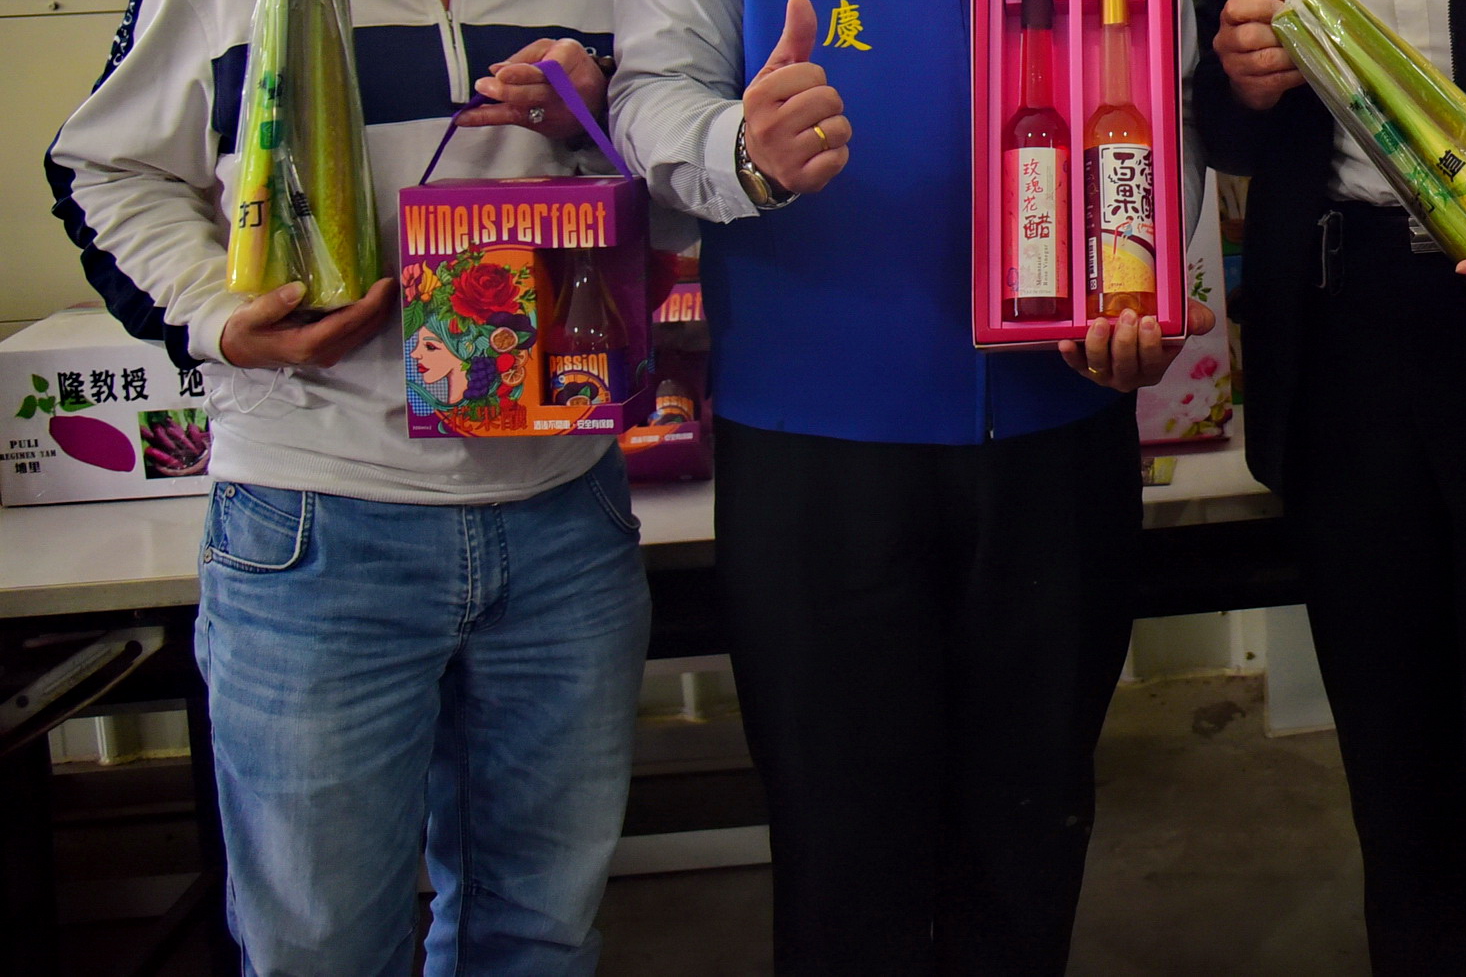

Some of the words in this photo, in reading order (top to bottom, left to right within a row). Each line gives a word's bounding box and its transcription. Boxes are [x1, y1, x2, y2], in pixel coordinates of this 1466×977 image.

[57, 367, 149, 406] 隆教授
[9, 438, 39, 449] PULI
